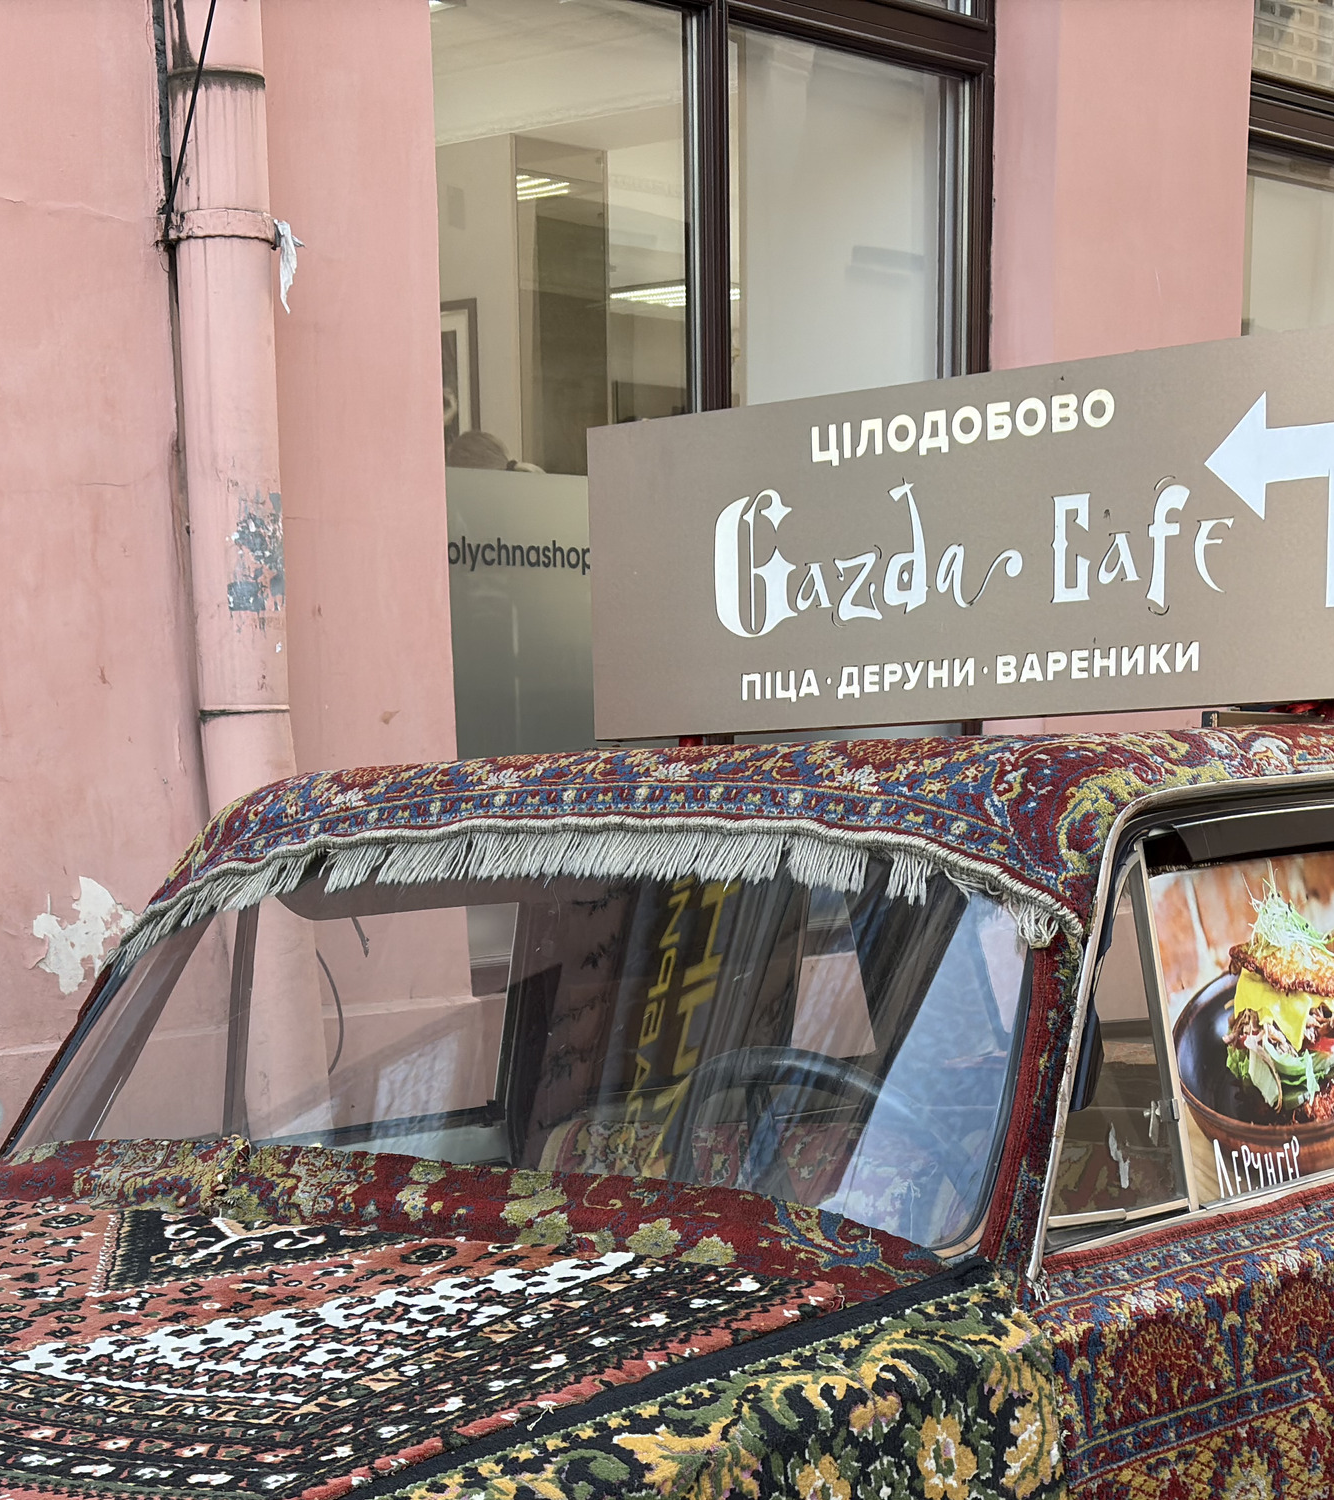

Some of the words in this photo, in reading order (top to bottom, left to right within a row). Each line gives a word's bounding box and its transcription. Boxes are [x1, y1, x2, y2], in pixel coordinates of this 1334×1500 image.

[810, 388, 1116, 467] ЦІЛОДОБОВО
[713, 477, 1023, 639] Gazda
[1051, 480, 1235, 614] Cafe
[740, 669, 820, 703] ПІЦА
[837, 658, 976, 700] ДЕРУНИ
[995, 641, 1202, 686] ВАРЕНИКИ
